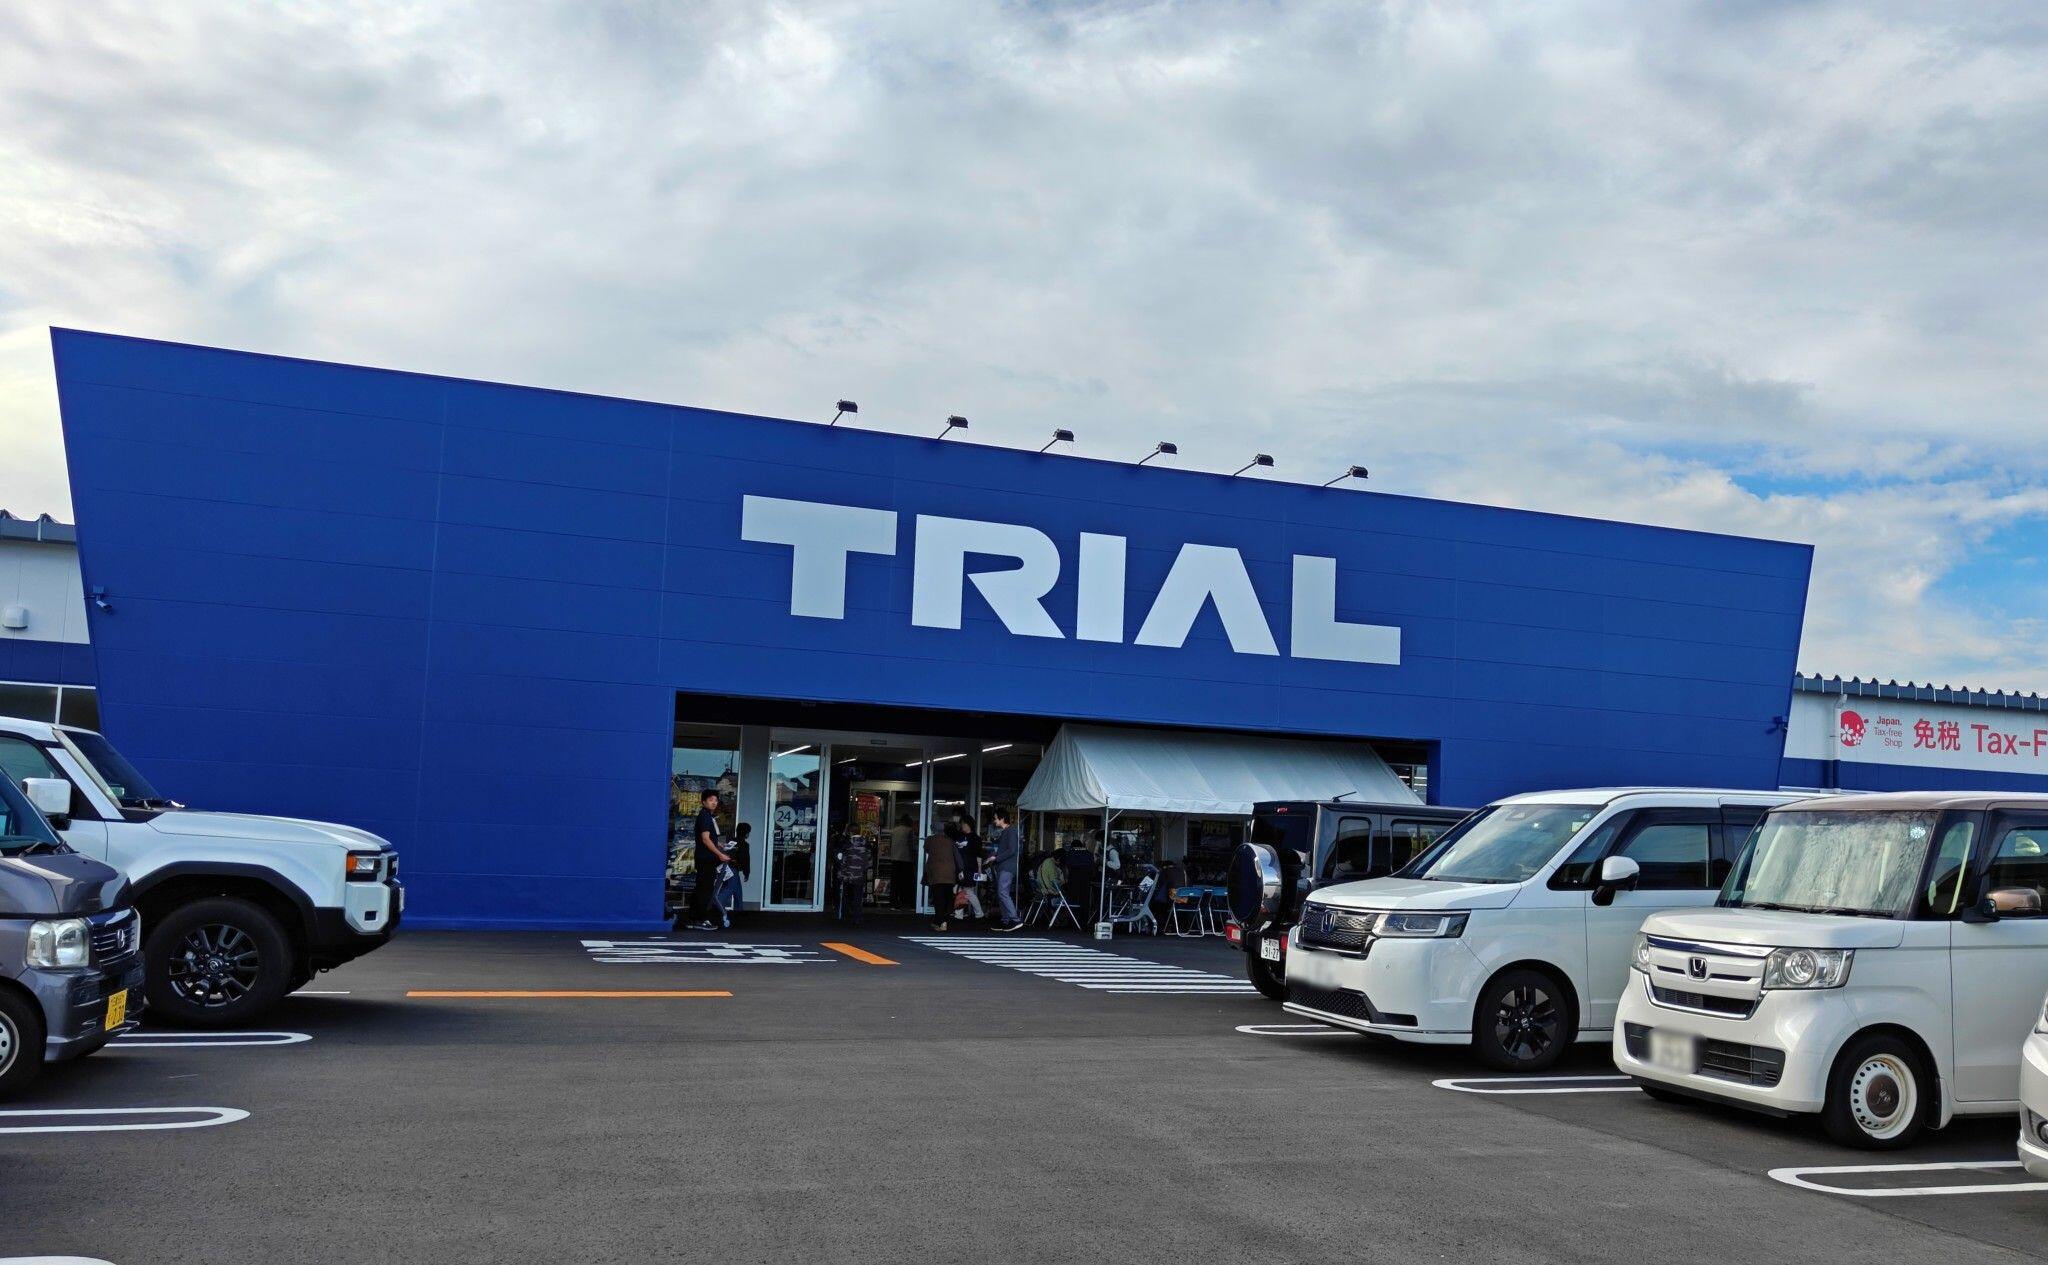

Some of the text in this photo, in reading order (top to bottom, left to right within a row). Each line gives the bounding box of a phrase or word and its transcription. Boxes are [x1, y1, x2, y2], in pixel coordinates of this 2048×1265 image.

[741, 494, 1401, 665] TRIAL
[1876, 715, 1903, 726] Japan.
[1873, 726, 1903, 737] Tax-free
[1913, 718, 1961, 750] 免税
[776, 810, 791, 823] 24
